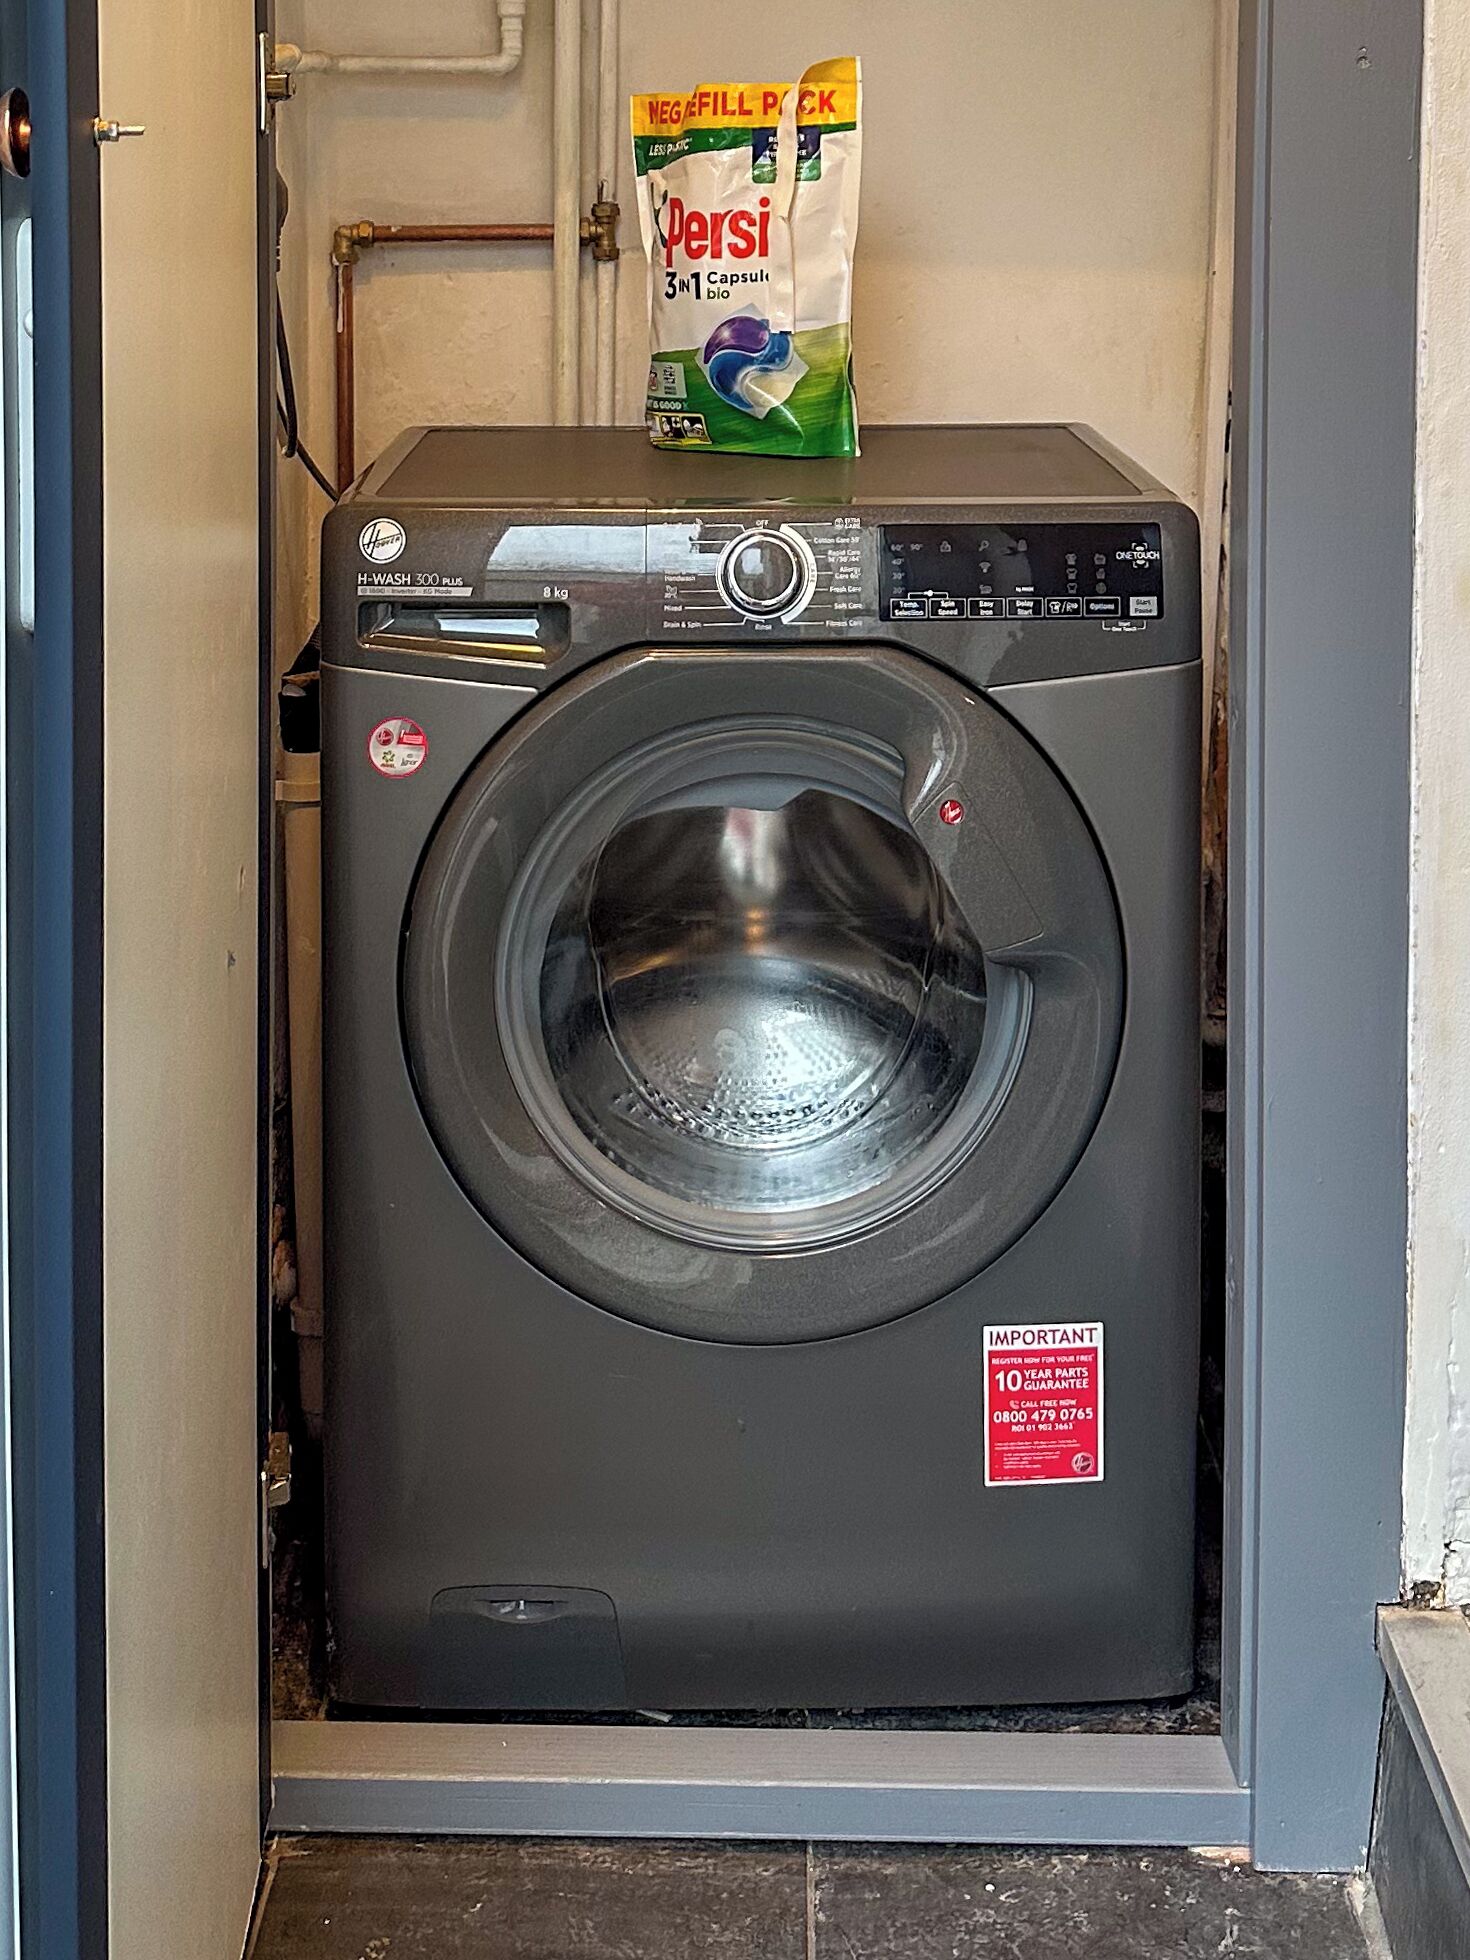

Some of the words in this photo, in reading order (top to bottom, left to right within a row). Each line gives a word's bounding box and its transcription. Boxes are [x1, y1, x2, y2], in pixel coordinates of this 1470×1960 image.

[682, 91, 753, 121] EFILL
[707, 287, 730, 300] bio
[357, 573, 411, 585] H-WASH
[415, 573, 439, 586] 300
[442, 577, 463, 587] PLUS
[543, 587, 550, 598] 8
[554, 586, 569, 600] kg
[989, 1327, 1097, 1347] IMPORTANT
[991, 1357, 1023, 1365] REGISTER
[1041, 1356, 1055, 1364] FOR
[1056, 1355, 1075, 1363] YOUR
[995, 1369, 1023, 1392] 10
[1023, 1368, 1052, 1380] YEAR
[1055, 1367, 1089, 1379] PARTS
[1023, 1379, 1089, 1391] GUARANTEE
[1021, 1400, 1038, 1408] CALL
[1040, 1399, 1058, 1408] FREE
[1059, 1398, 1077, 1406] NOW
[992, 1410, 1027, 1423] 0800
[1031, 1409, 1056, 1422] 479
[1060, 1407, 1094, 1421] 0765
[1026, 1424, 1036, 1432] 01
